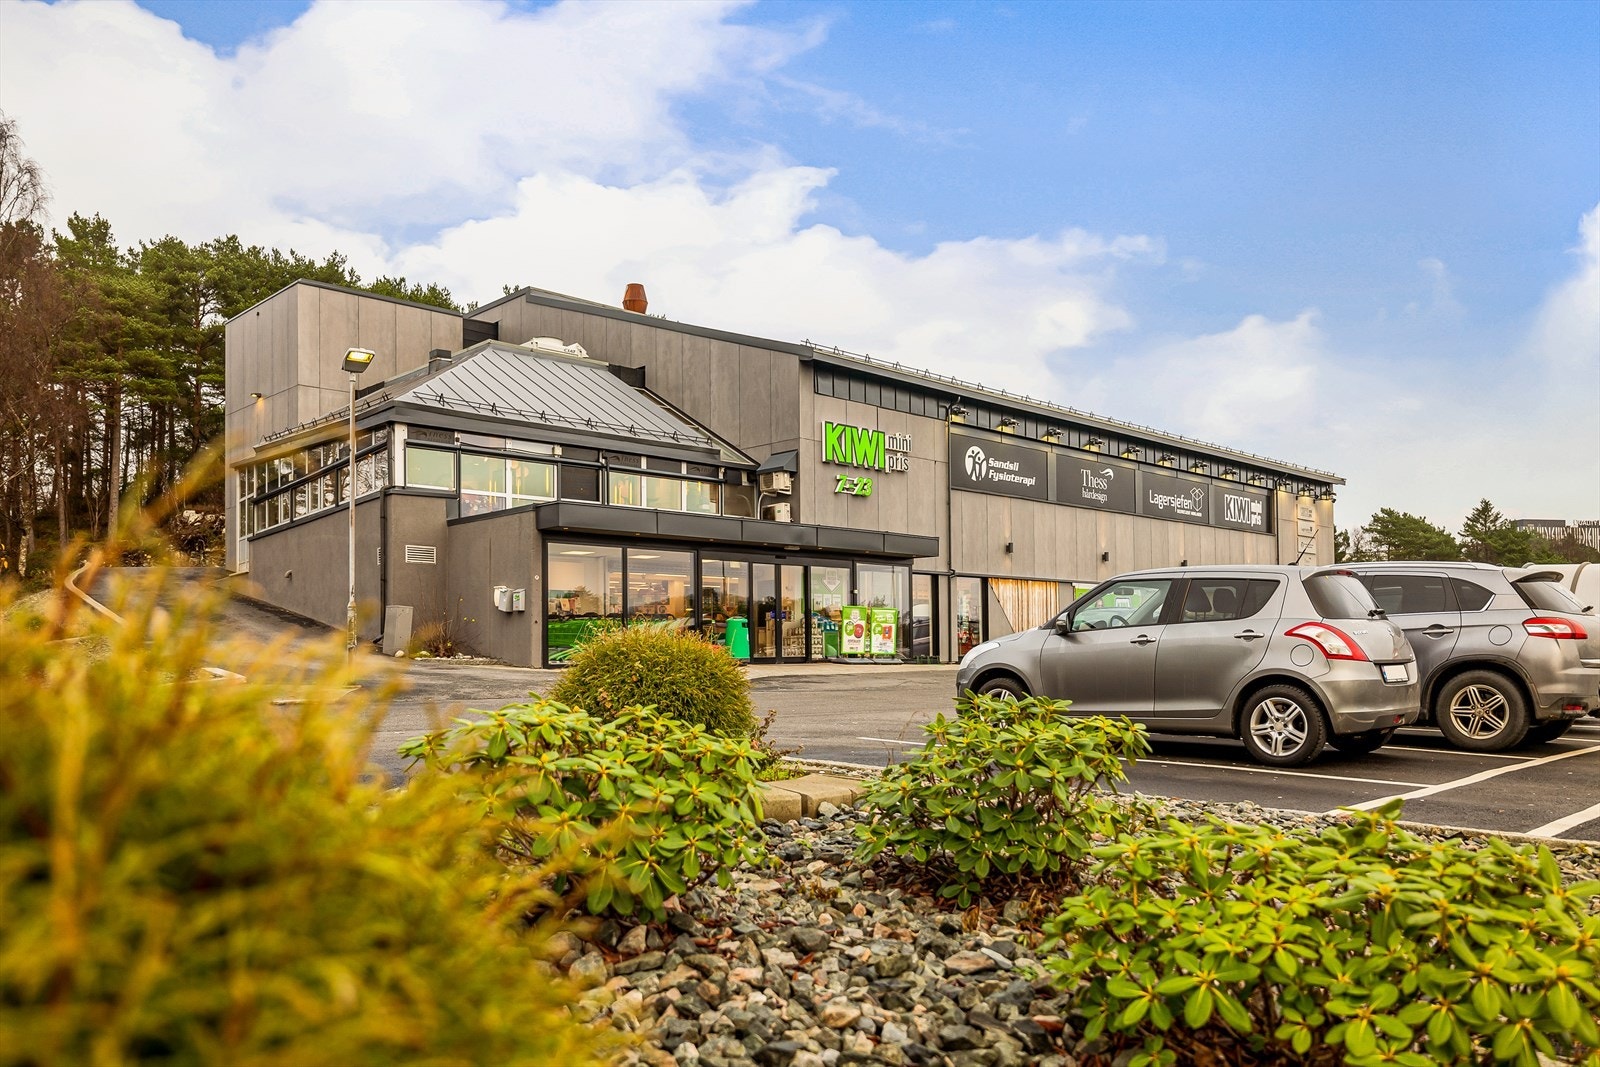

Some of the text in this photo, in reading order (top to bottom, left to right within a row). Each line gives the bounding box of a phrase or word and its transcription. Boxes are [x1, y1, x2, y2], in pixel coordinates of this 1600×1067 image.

[822, 421, 885, 470] KIWI
[886, 433, 912, 453] mini
[886, 453, 910, 473] pris
[988, 457, 1019, 471] Sandsli
[835, 474, 873, 497] 7-23
[988, 469, 1036, 487] Fysioterapi
[1080, 468, 1108, 490] Thess
[1149, 489, 1193, 513] Lagersjefen
[1224, 493, 1250, 525] KIWI
